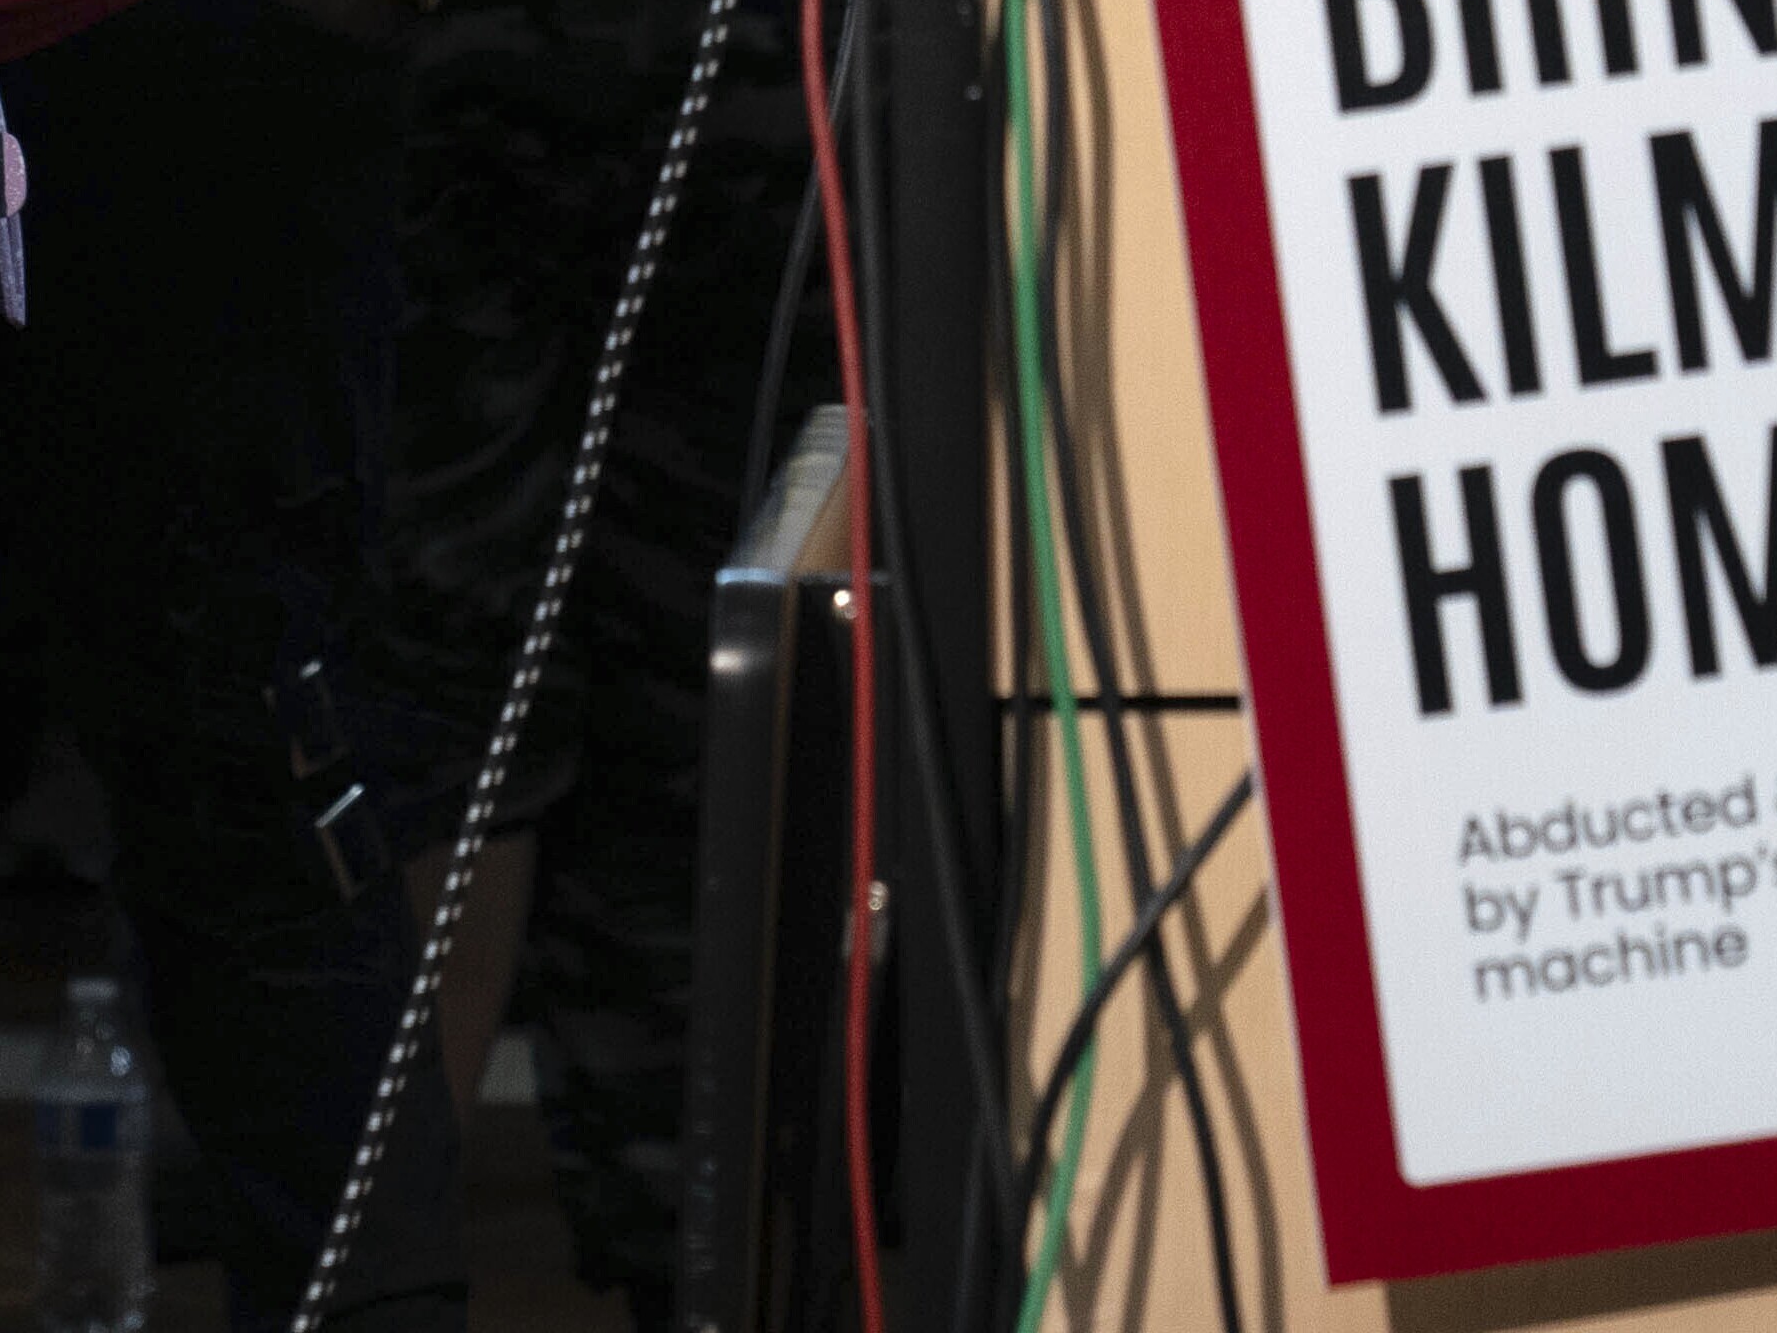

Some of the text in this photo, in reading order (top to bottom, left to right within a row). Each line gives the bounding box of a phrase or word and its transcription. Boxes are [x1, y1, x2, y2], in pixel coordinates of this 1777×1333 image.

[1459, 778, 1758, 862] Abducted
[1464, 887, 1537, 939] by
[1474, 927, 1748, 998] machine
